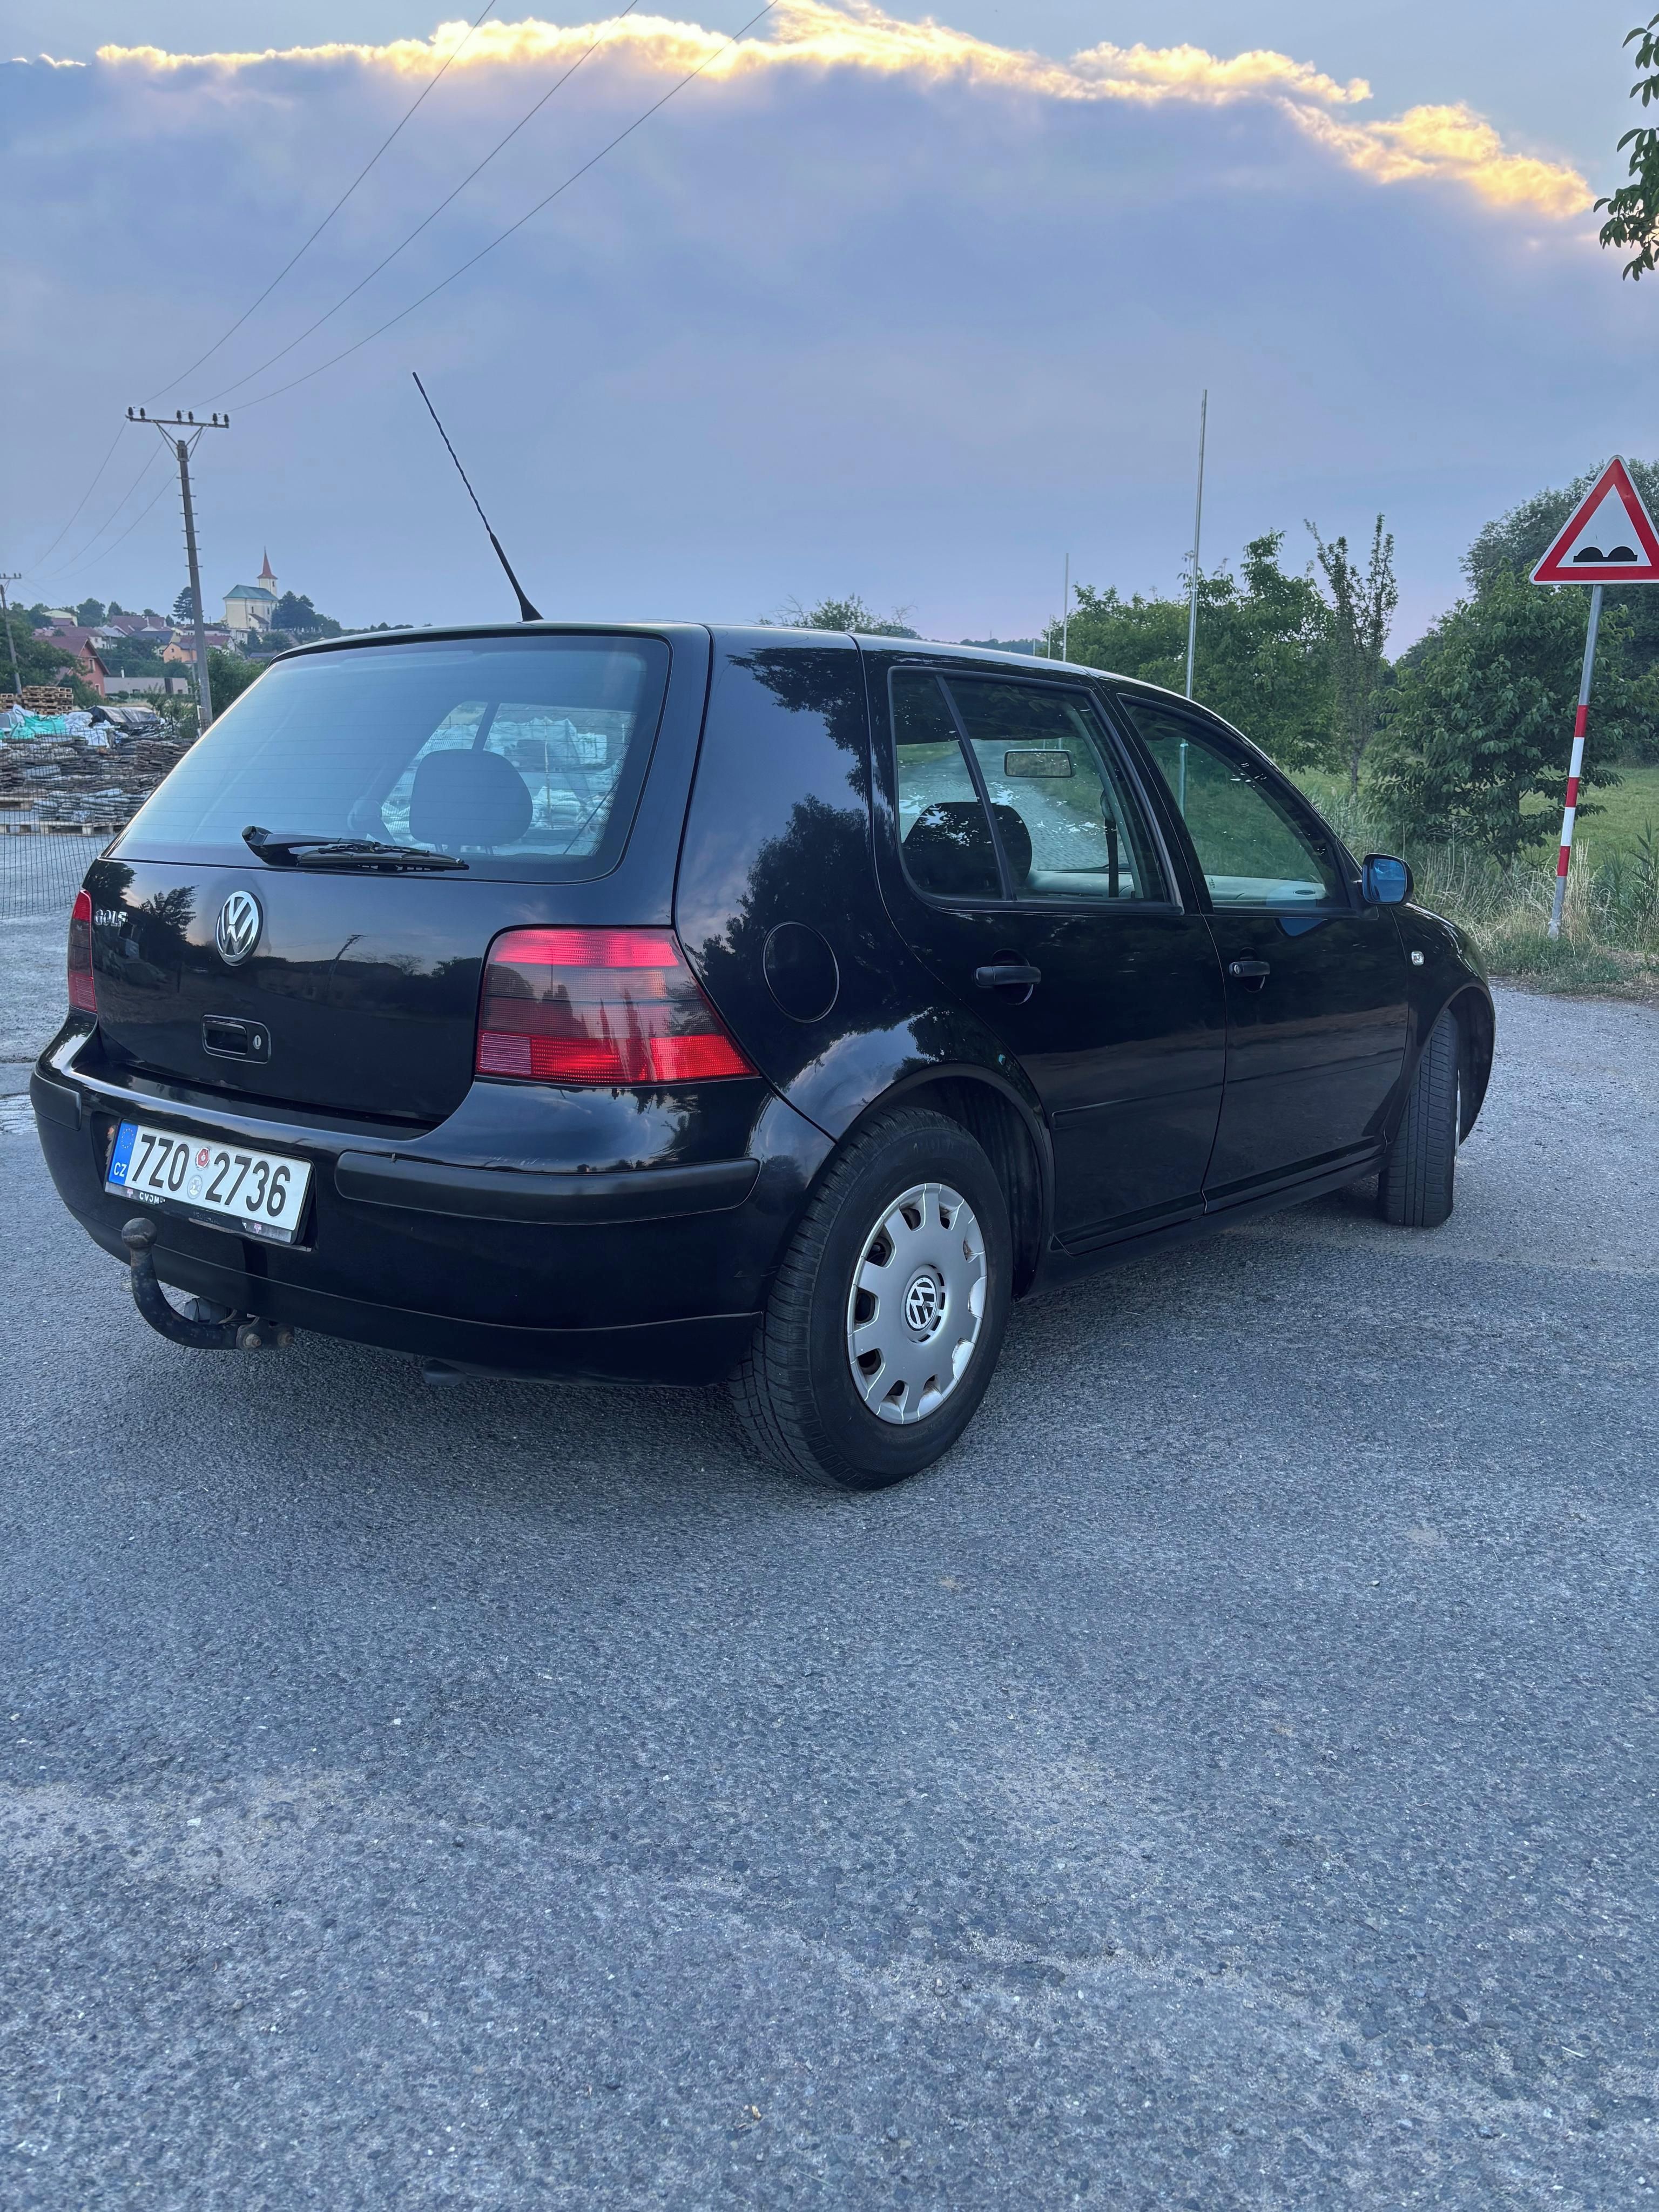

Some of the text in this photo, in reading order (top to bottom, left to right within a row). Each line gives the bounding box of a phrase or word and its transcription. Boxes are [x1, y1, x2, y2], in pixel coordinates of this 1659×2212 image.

[95, 909, 129, 928] GOLF
[113, 1162, 126, 1178] CZ
[132, 1134, 291, 1217] 7Z0 2736
